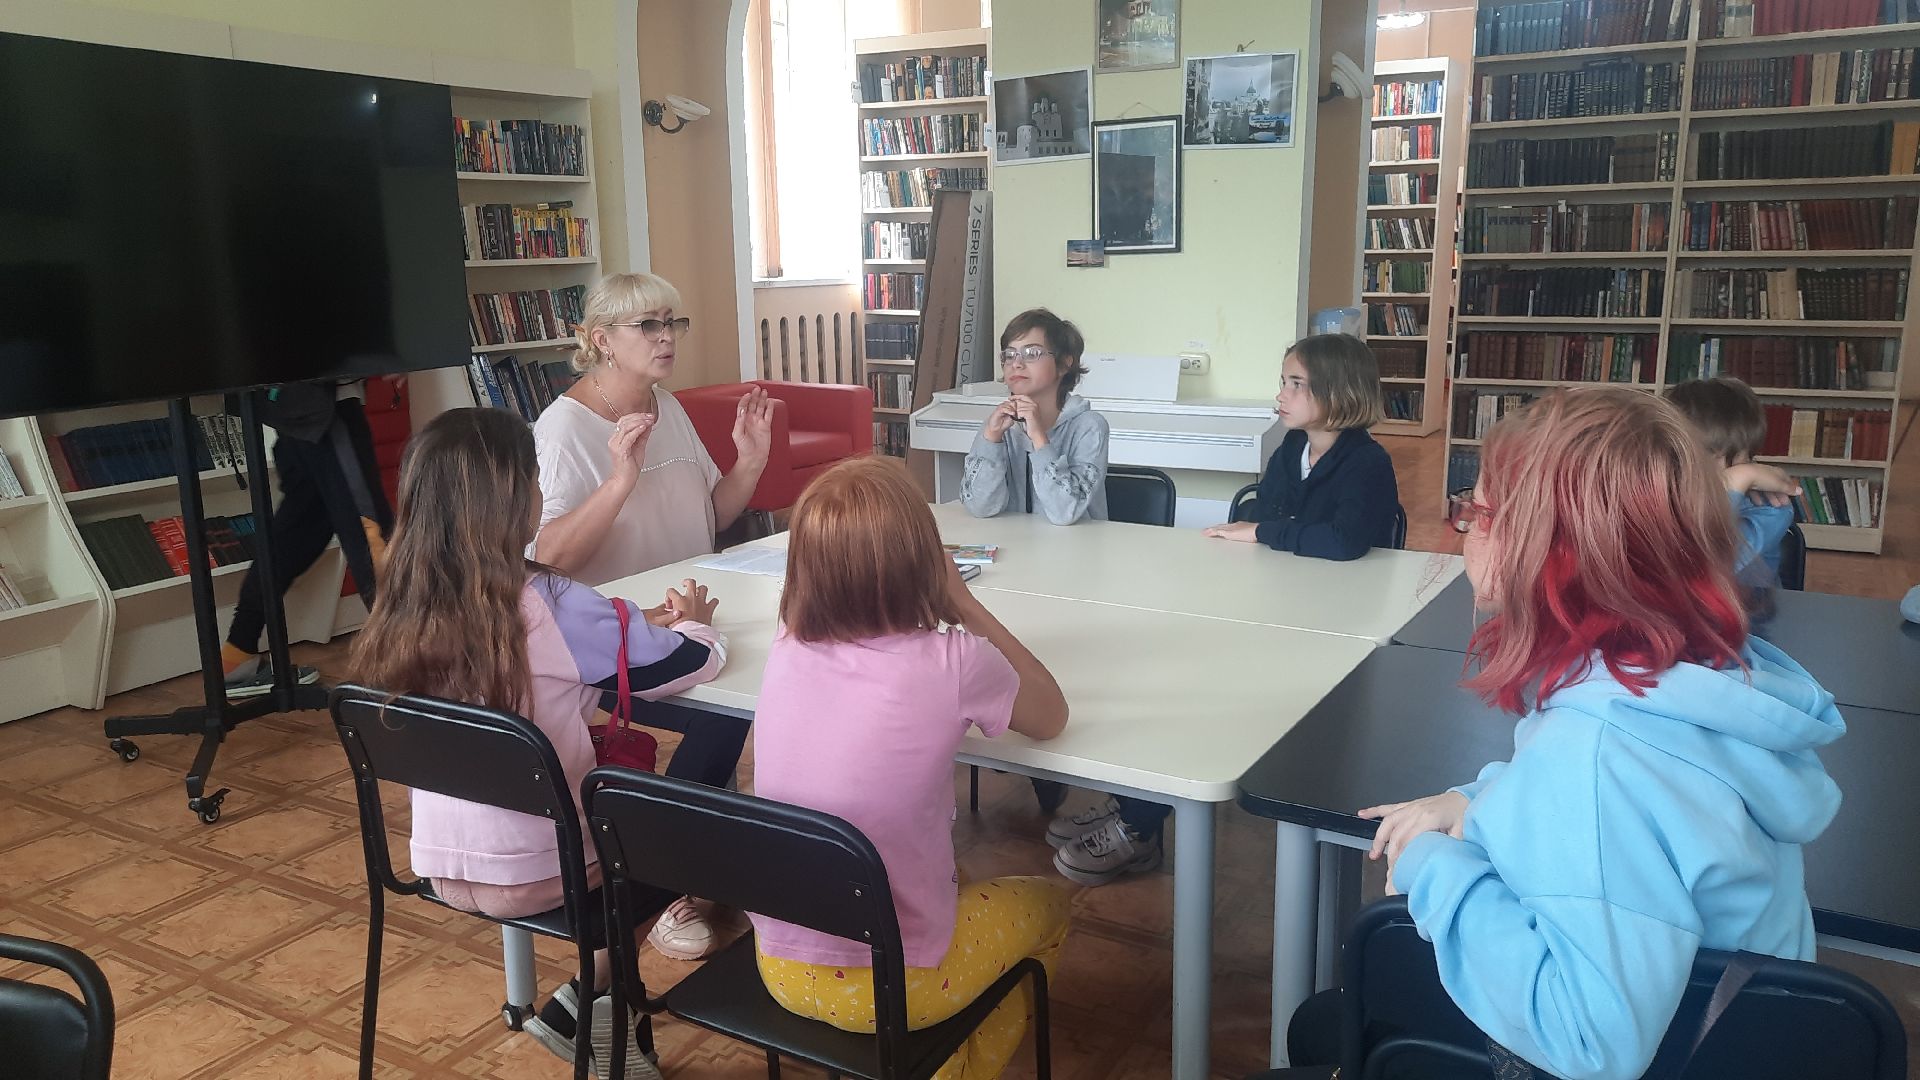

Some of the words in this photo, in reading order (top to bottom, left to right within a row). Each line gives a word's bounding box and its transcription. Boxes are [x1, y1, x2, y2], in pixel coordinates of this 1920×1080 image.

[973, 204, 983, 215] 7
[968, 218, 982, 276] SERIES
[963, 286, 977, 344] TU7100
